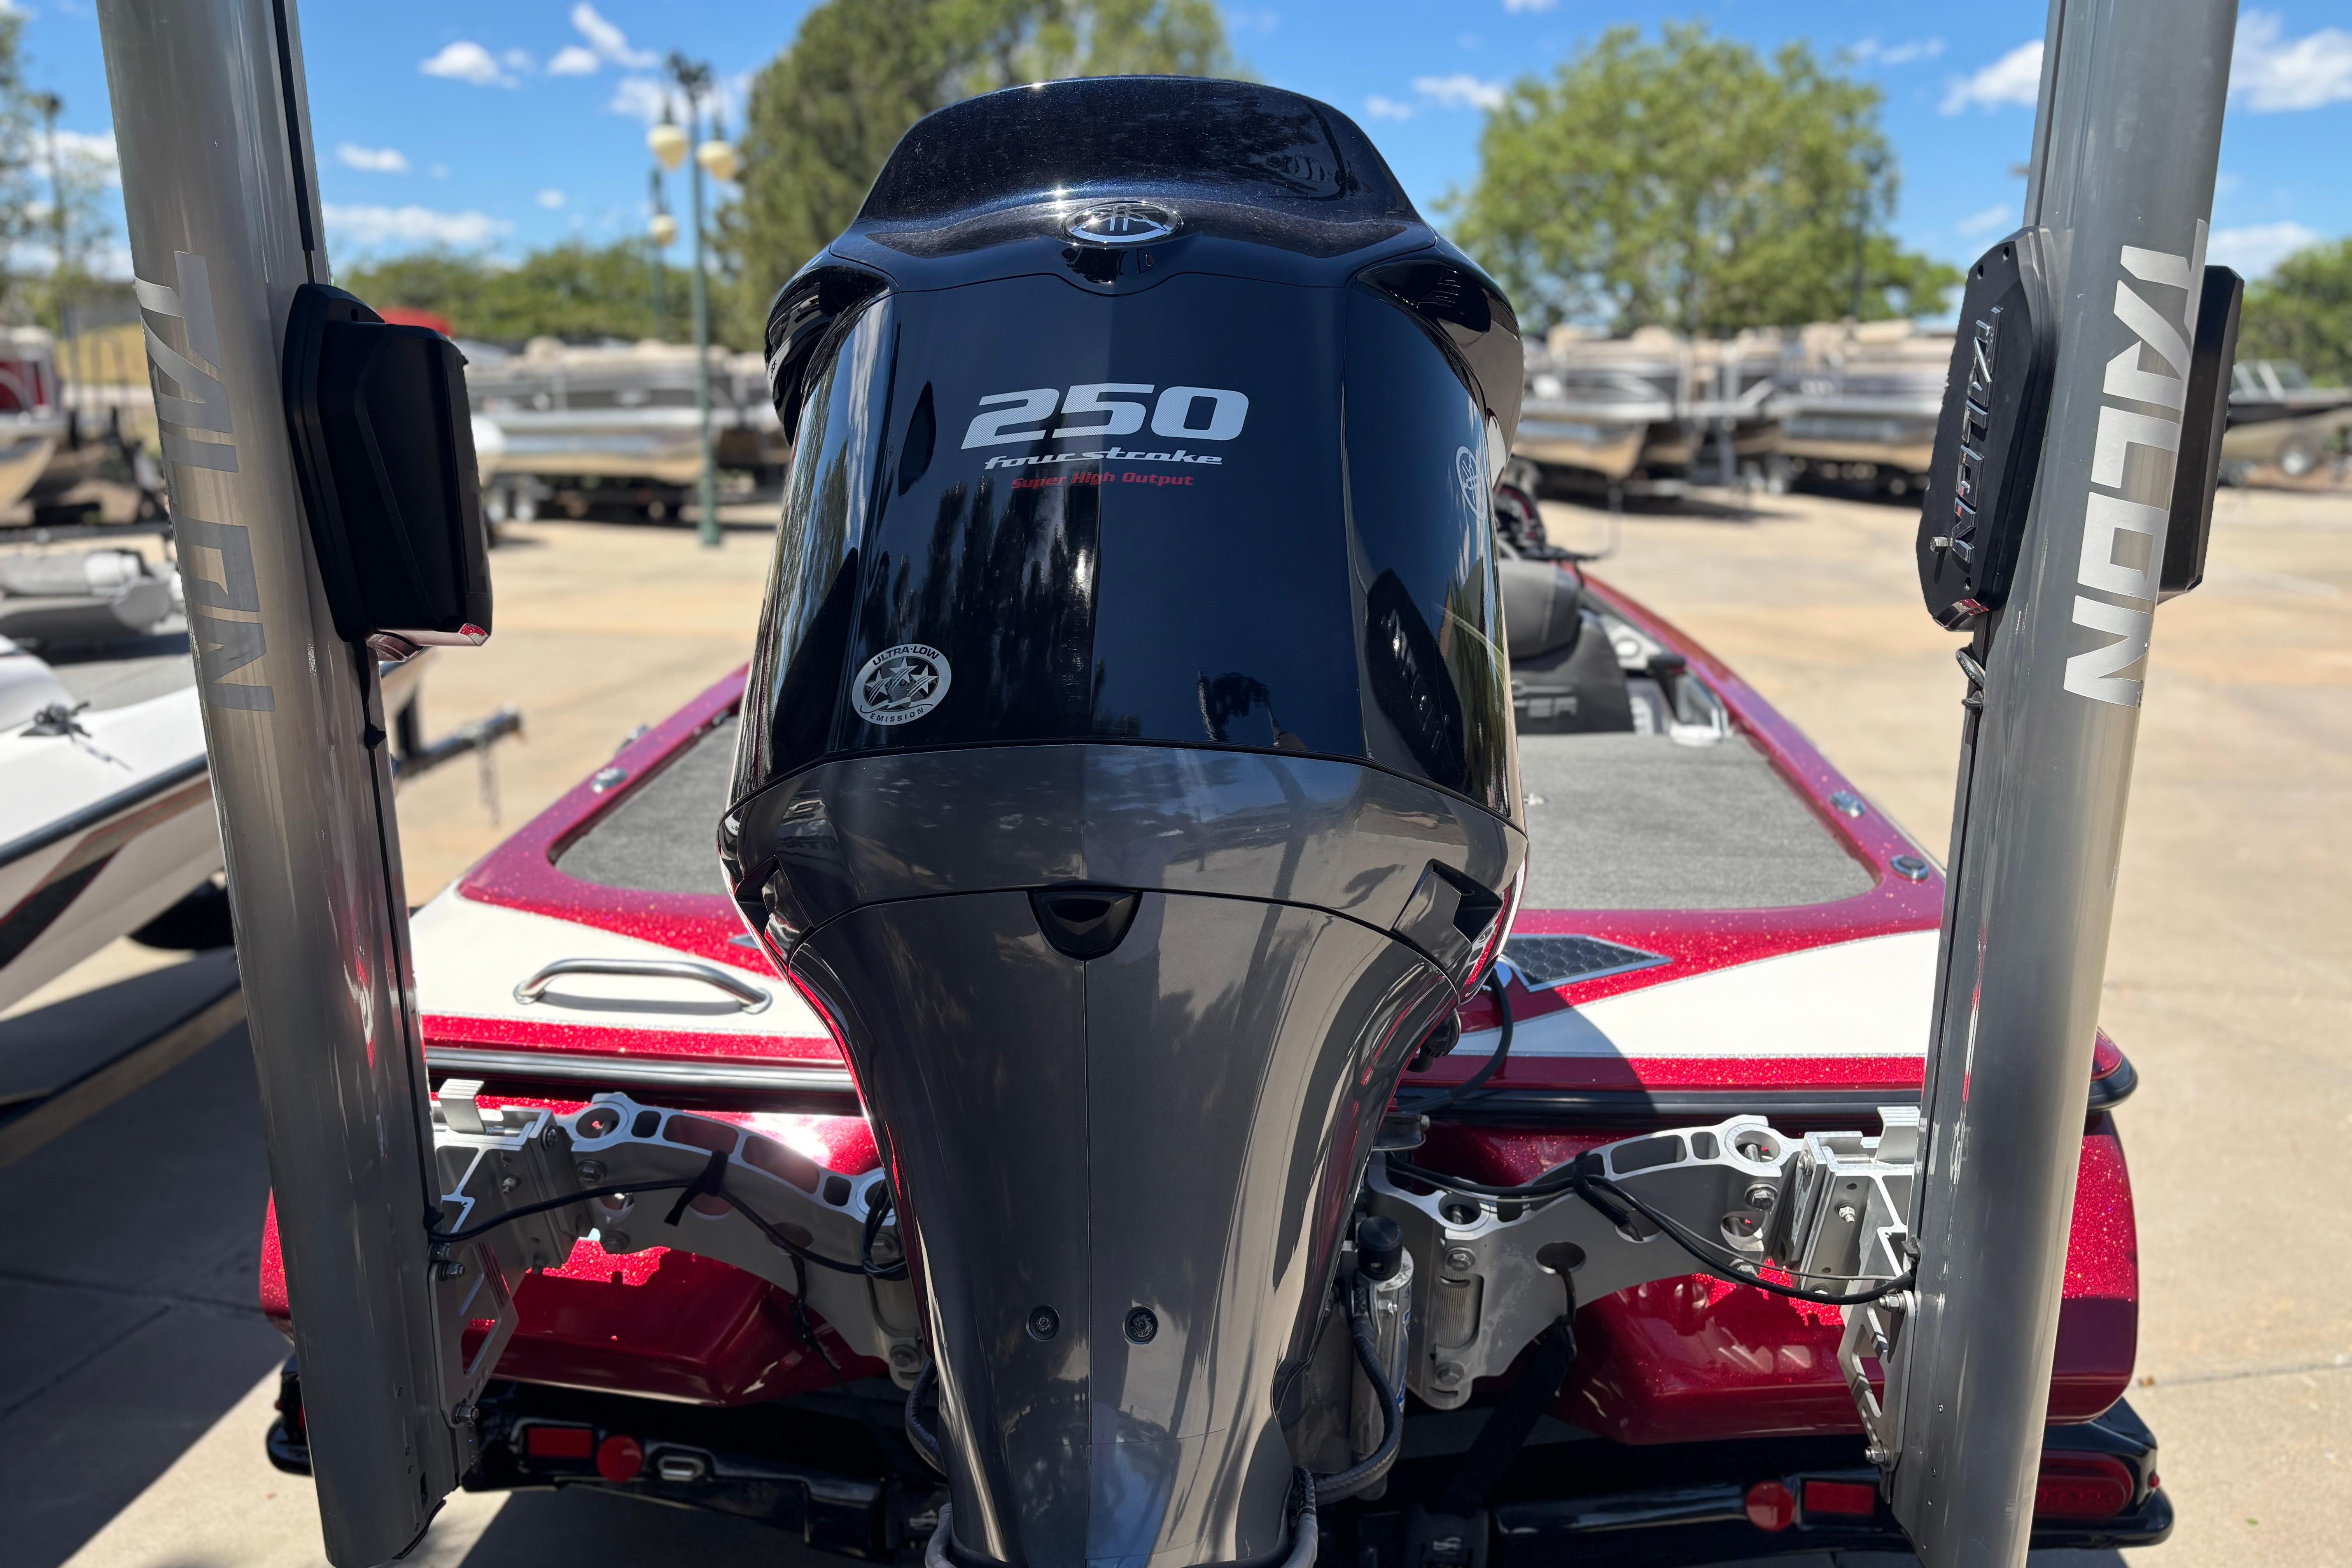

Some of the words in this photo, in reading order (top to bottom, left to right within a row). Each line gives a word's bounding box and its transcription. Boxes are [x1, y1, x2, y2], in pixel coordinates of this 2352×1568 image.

[134, 251, 275, 712] TALON
[961, 383, 1249, 450] 250
[1011, 476, 1068, 490] Super
[1071, 471, 1115, 485] High
[1122, 472, 1194, 486] Output
[1951, 306, 2002, 564] TALON
[2064, 219, 2207, 708] TALON
[870, 707, 924, 722] EMISSION
